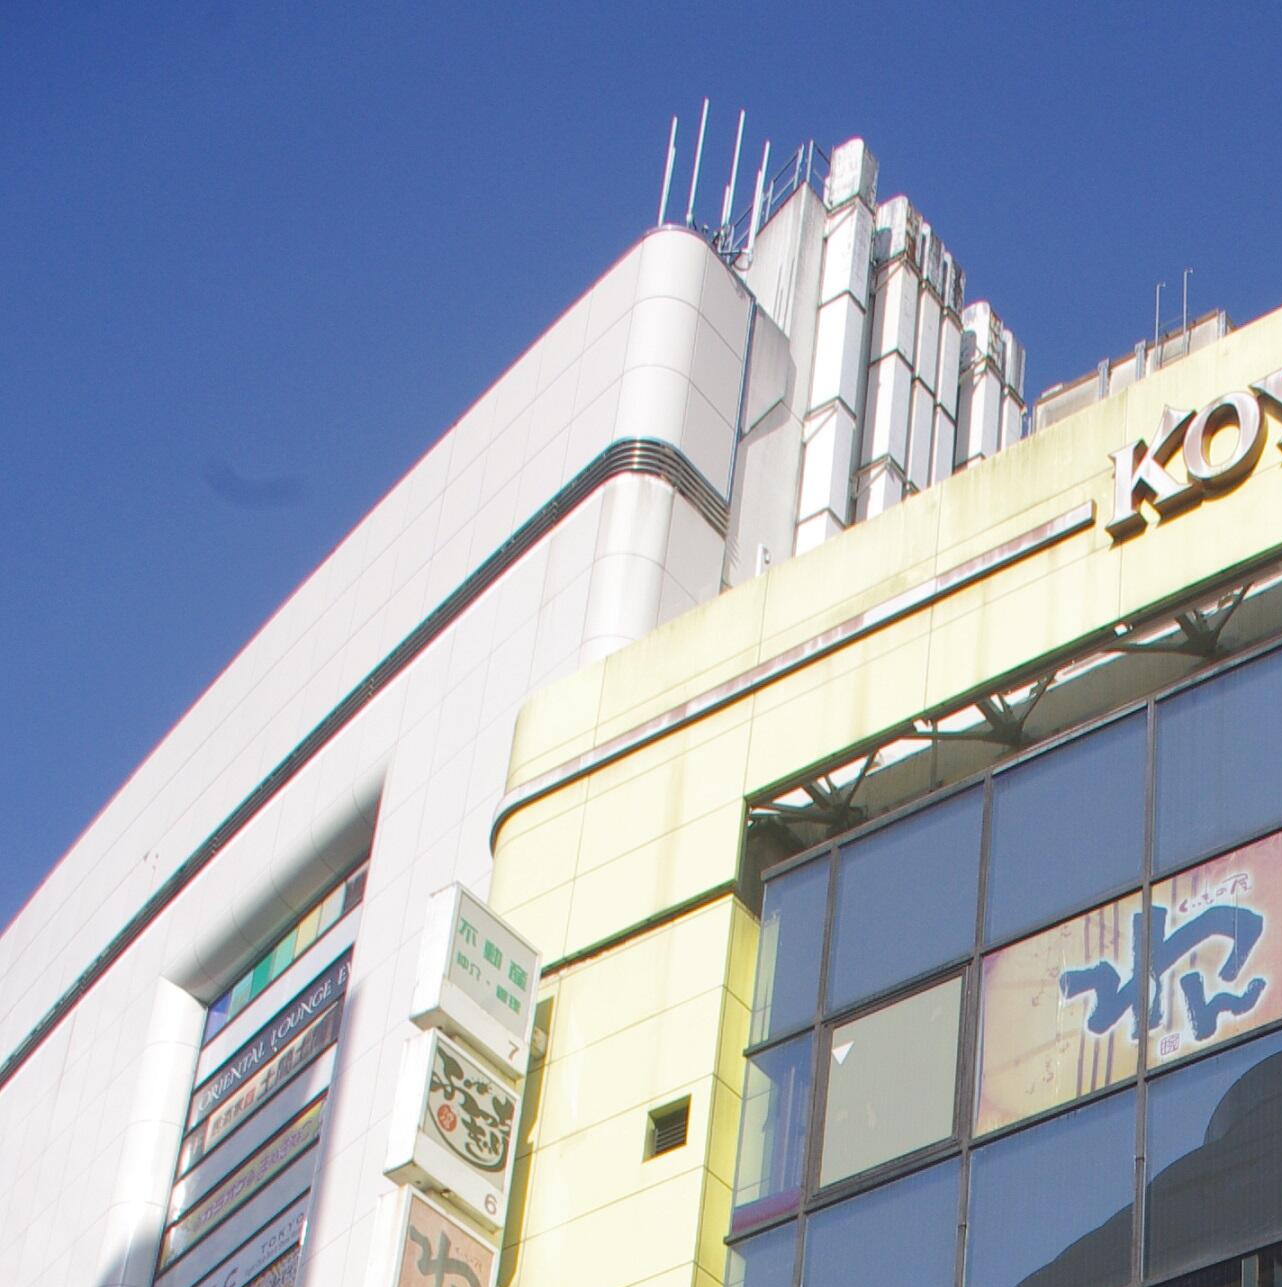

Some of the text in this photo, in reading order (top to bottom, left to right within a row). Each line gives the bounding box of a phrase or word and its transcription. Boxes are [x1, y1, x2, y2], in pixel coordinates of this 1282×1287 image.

[459, 917, 529, 992] 不動産
[1058, 903, 1268, 1042] わん
[269, 977, 333, 1053] LOUNGE
[507, 1039, 520, 1061] 7
[484, 1193, 498, 1217] 6
